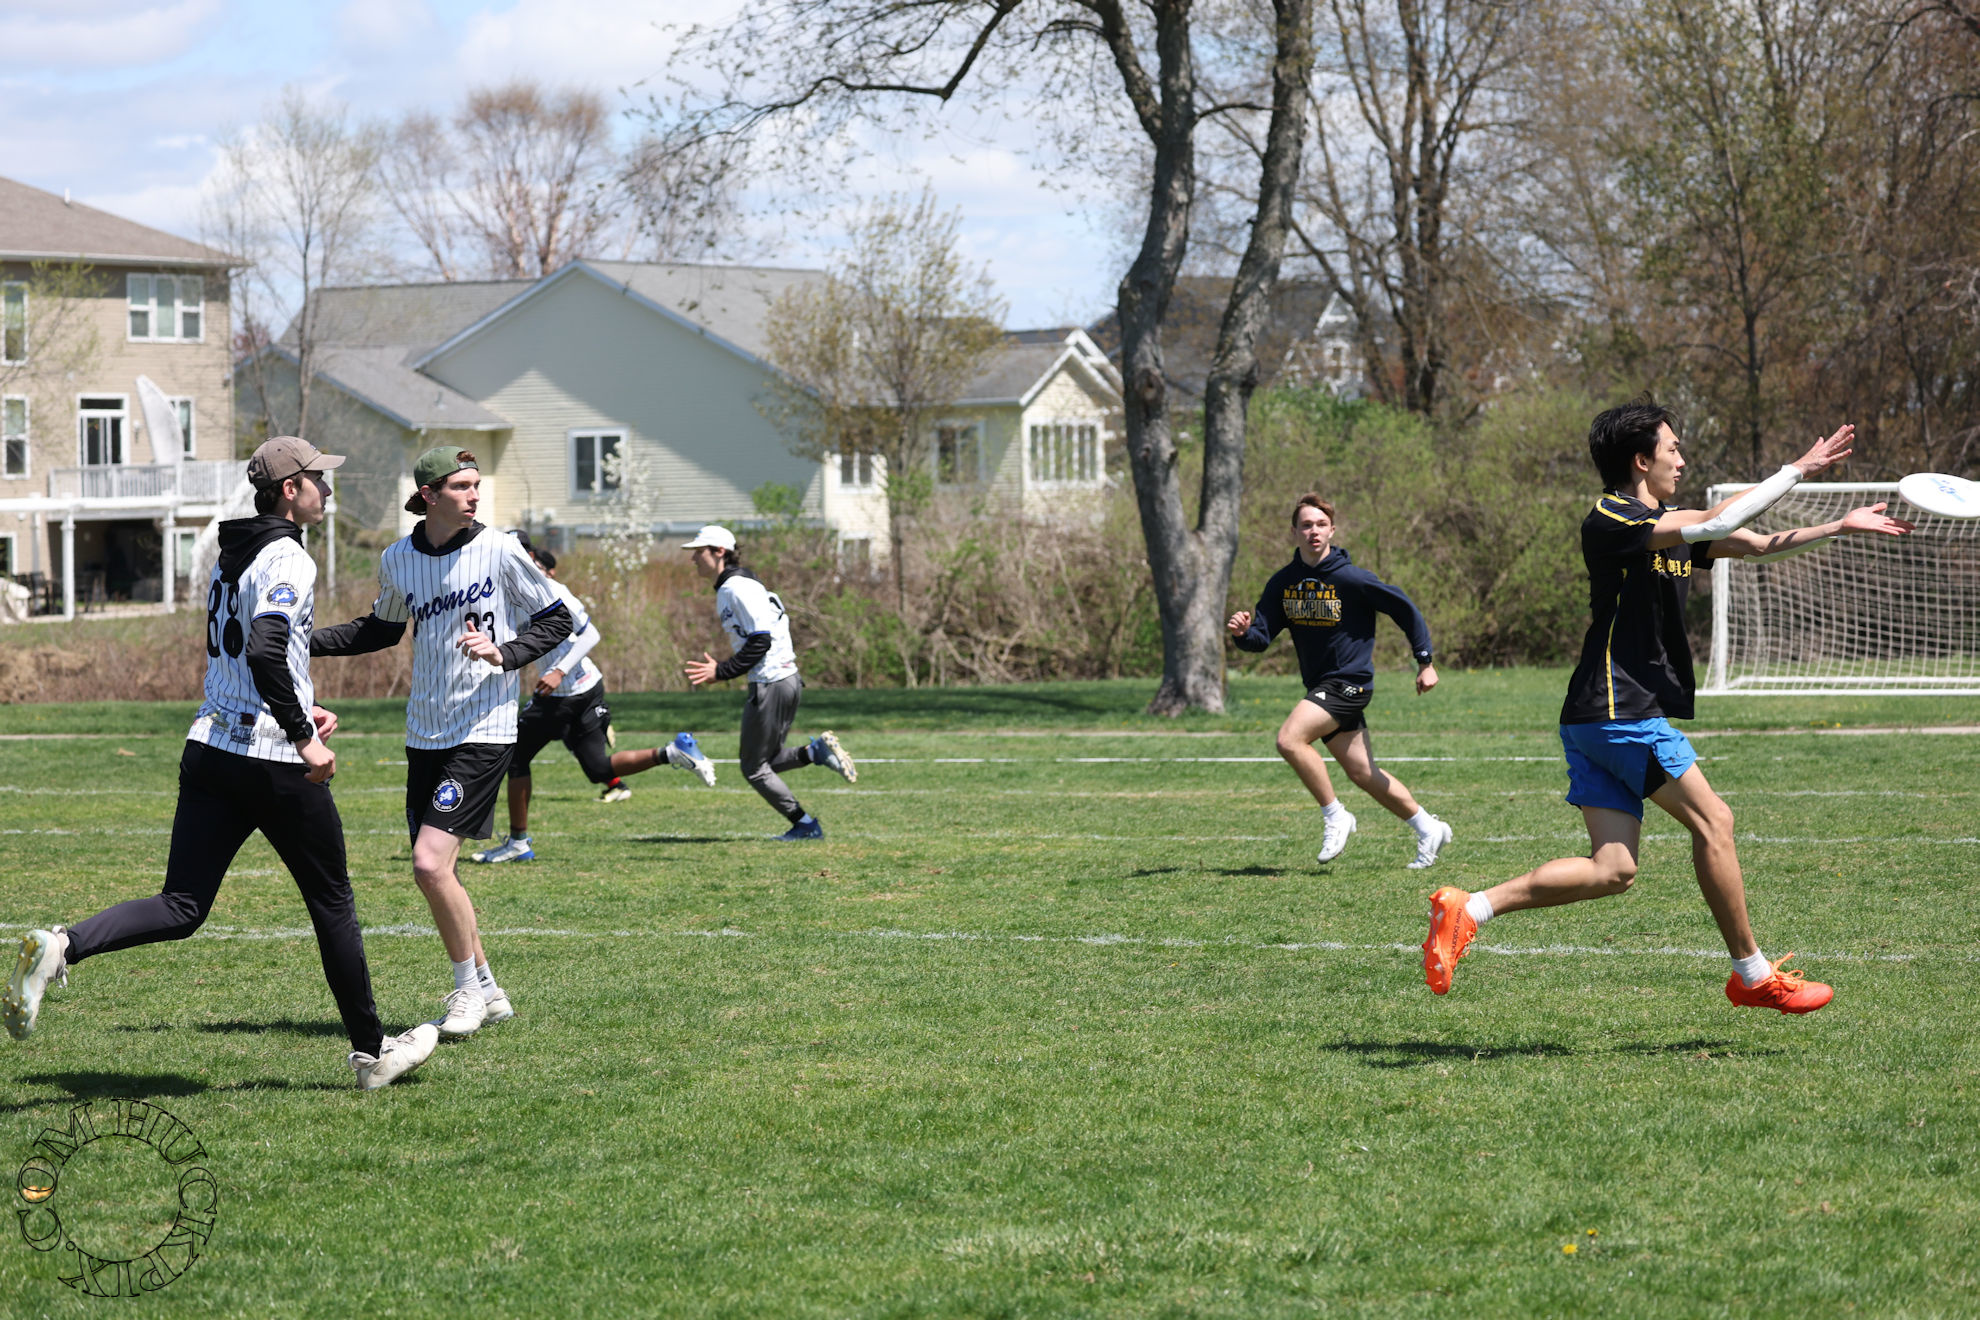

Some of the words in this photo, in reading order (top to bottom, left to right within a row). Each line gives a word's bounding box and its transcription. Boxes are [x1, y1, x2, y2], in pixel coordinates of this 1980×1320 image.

[1284, 588, 1339, 600] NATIONAL
[207, 579, 245, 660] 88
[1282, 599, 1343, 622] CHAMPIONS
